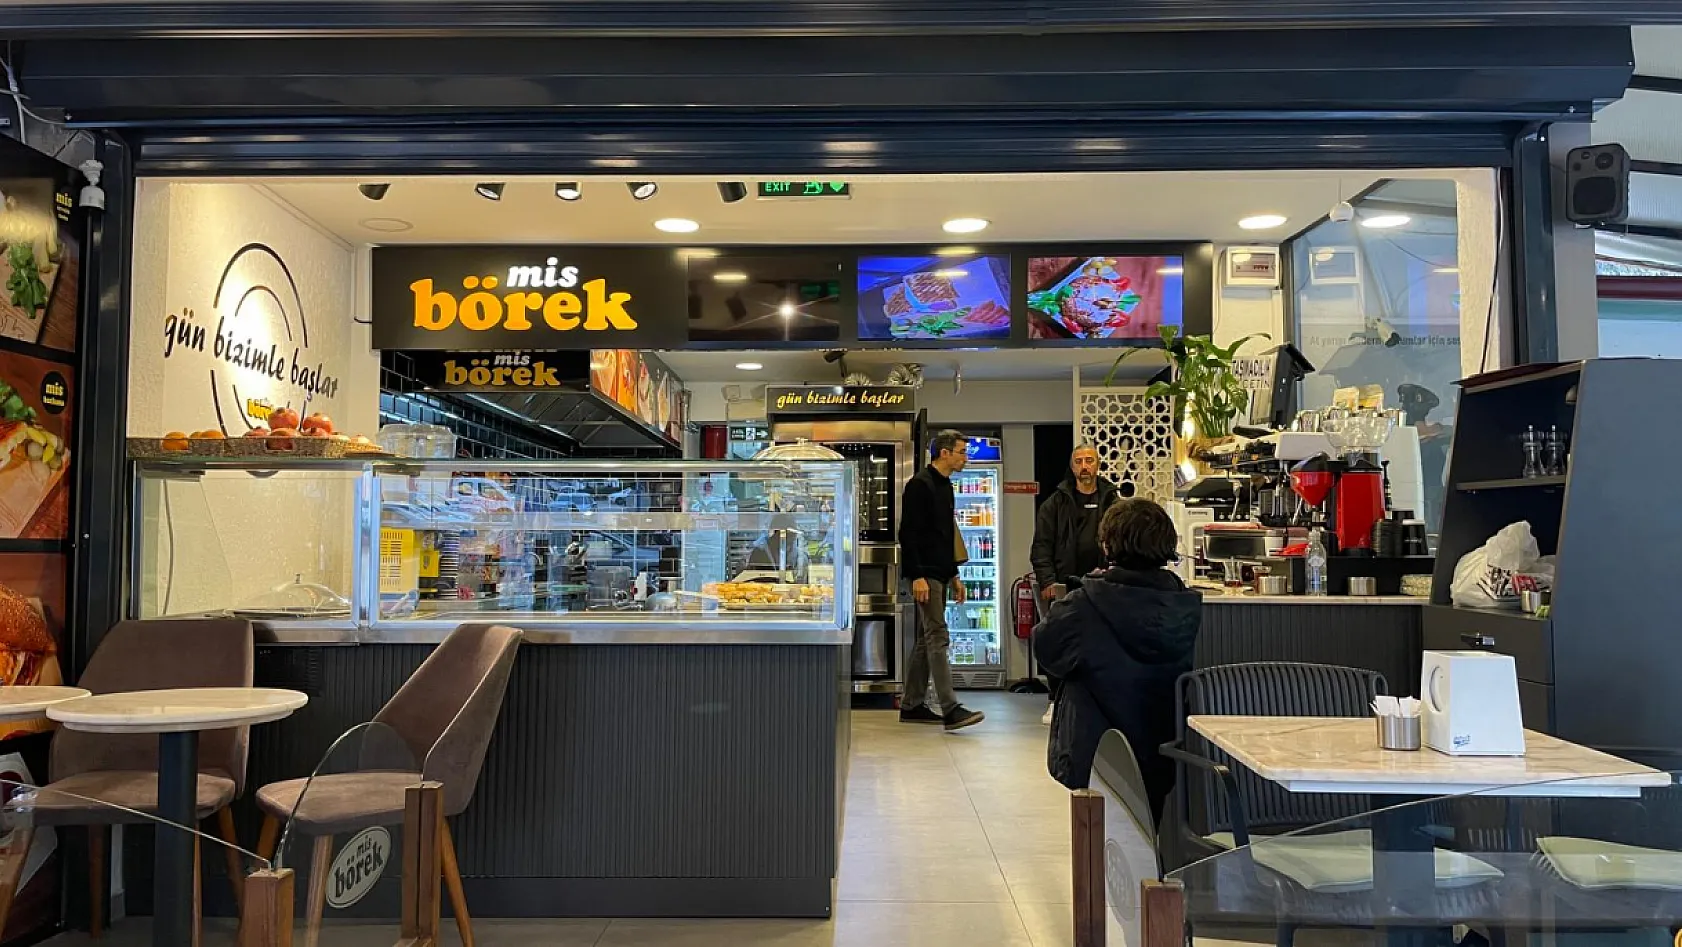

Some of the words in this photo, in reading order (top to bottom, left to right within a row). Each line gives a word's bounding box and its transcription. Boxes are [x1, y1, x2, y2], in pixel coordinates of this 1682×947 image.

[765, 181, 790, 192] EXIT
[506, 257, 579, 288] mis
[409, 275, 638, 331] börek
[164, 307, 206, 358] gün
[214, 316, 285, 381] bizimle
[290, 347, 338, 402] başlar
[494, 350, 530, 366] mis
[444, 359, 561, 386] börek
[777, 392, 802, 408] gün
[807, 390, 856, 404] bizimle
[861, 390, 904, 407] başlar
[357, 834, 372, 858] mis
[335, 841, 384, 898] börek
